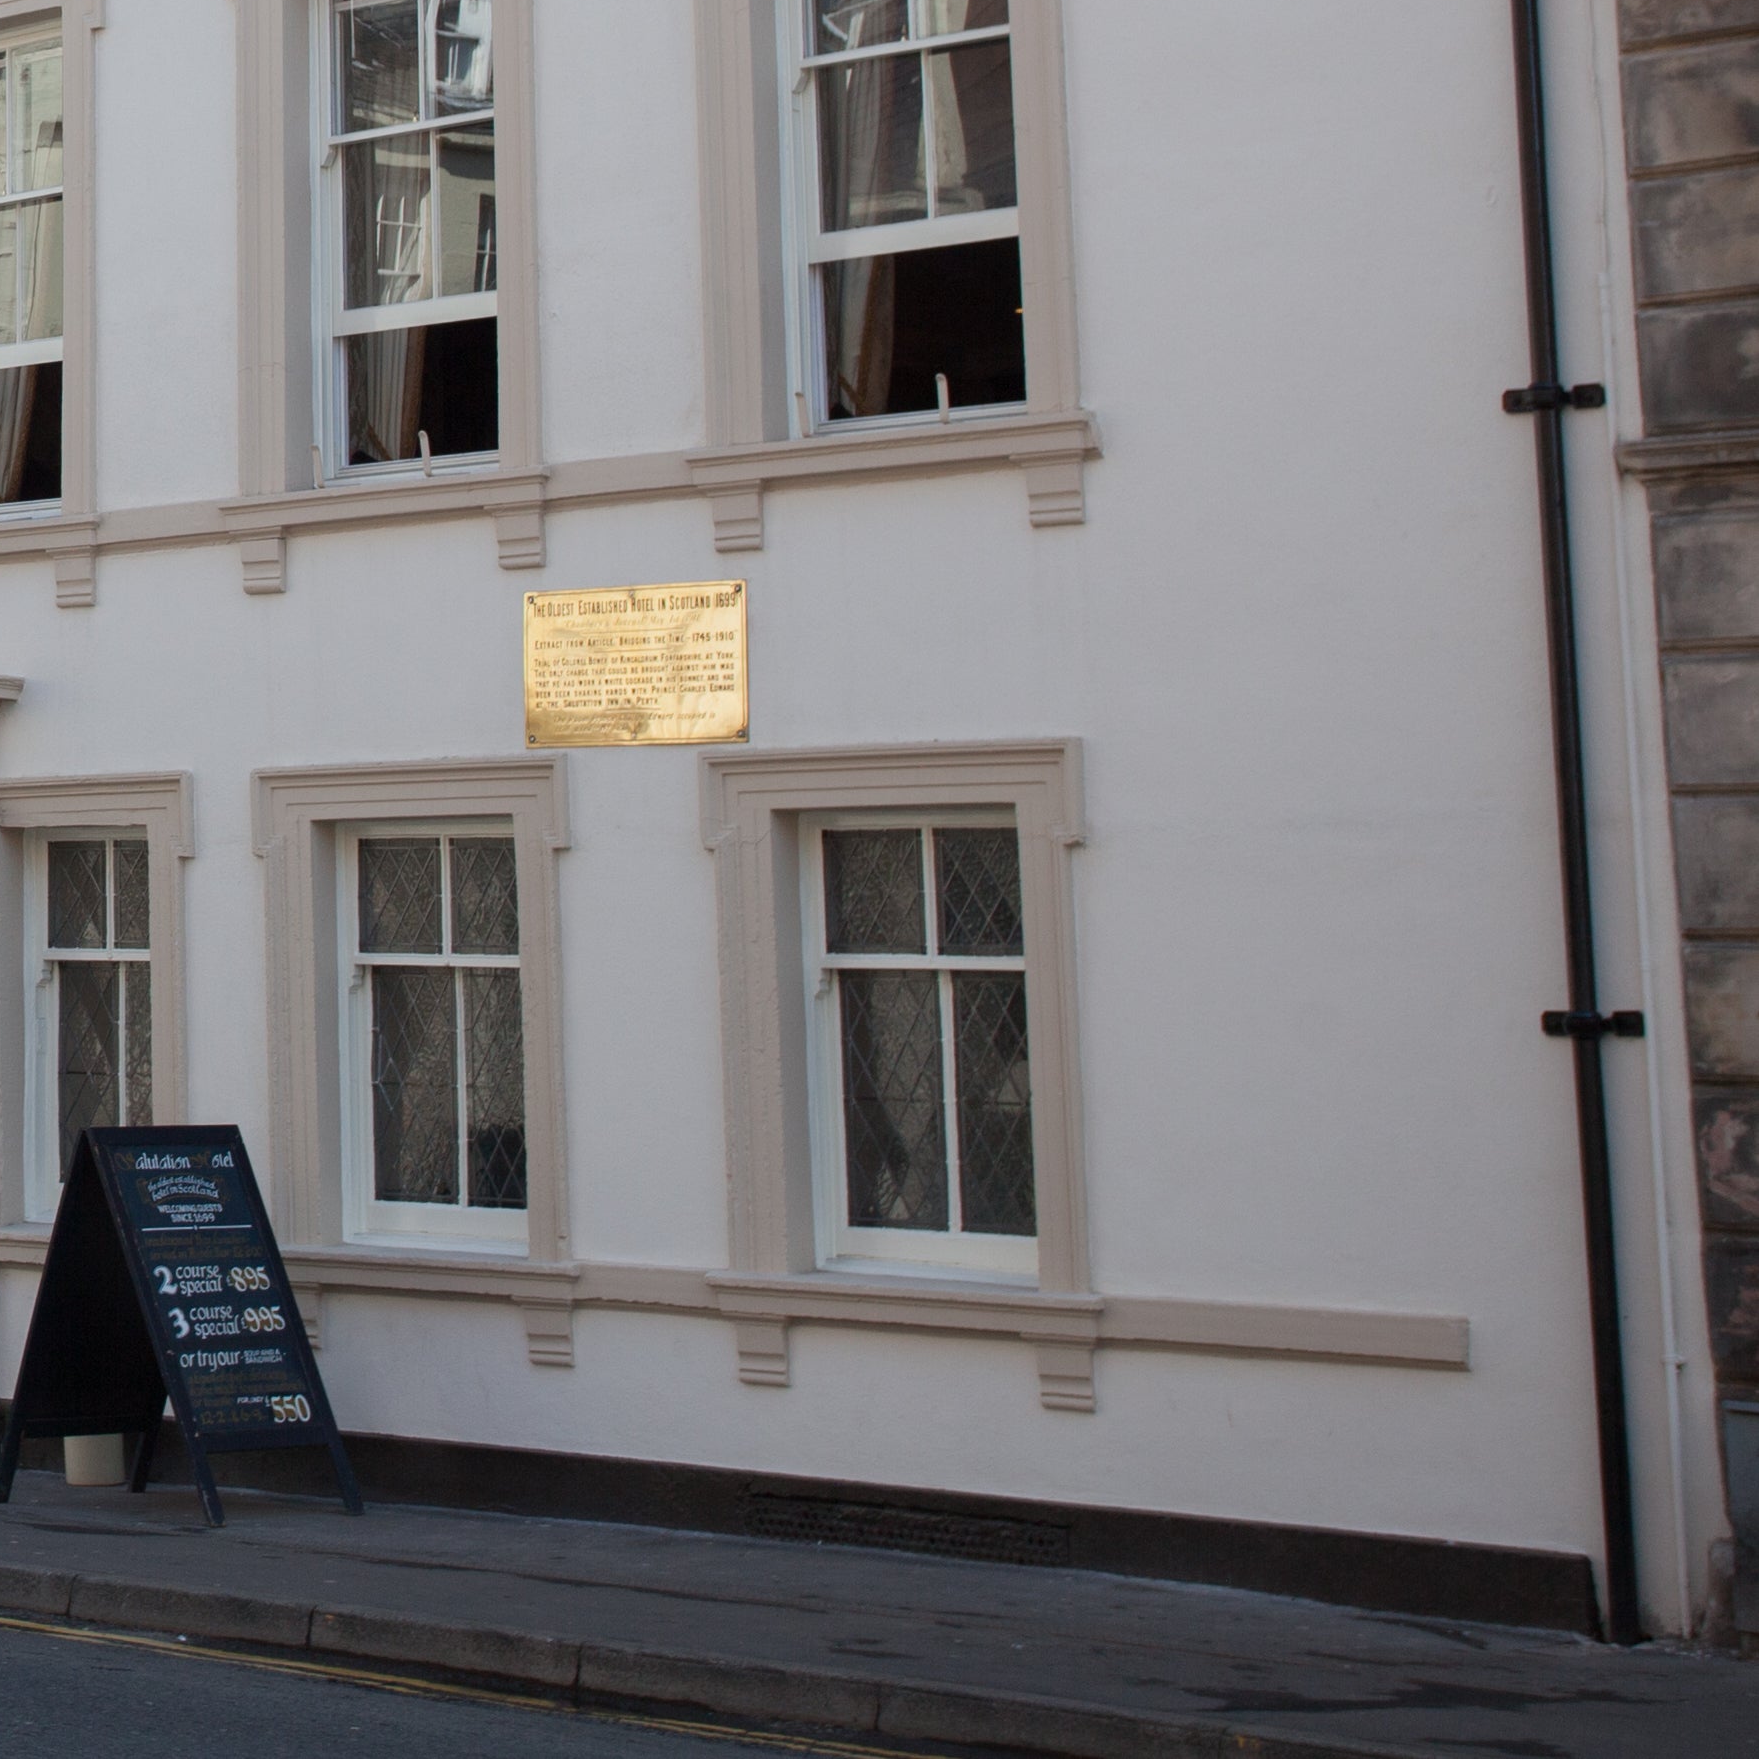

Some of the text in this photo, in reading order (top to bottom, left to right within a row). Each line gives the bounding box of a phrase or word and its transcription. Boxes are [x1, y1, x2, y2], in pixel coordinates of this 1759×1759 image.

[533, 592, 736, 618] THE OLDEST ESTABLISHED HOTEL IN SCOTLAND 1699
[534, 640, 562, 650] EXTRACT
[178, 1185, 219, 1199] Scotland
[194, 1212, 215, 1223] 1699
[153, 1264, 178, 1295] 2
[175, 1265, 220, 1279] course
[180, 1274, 223, 1297] special
[168, 1307, 190, 1339] 3
[189, 1305, 233, 1321] course
[194, 1314, 240, 1339] special
[179, 1353, 196, 1368] or
